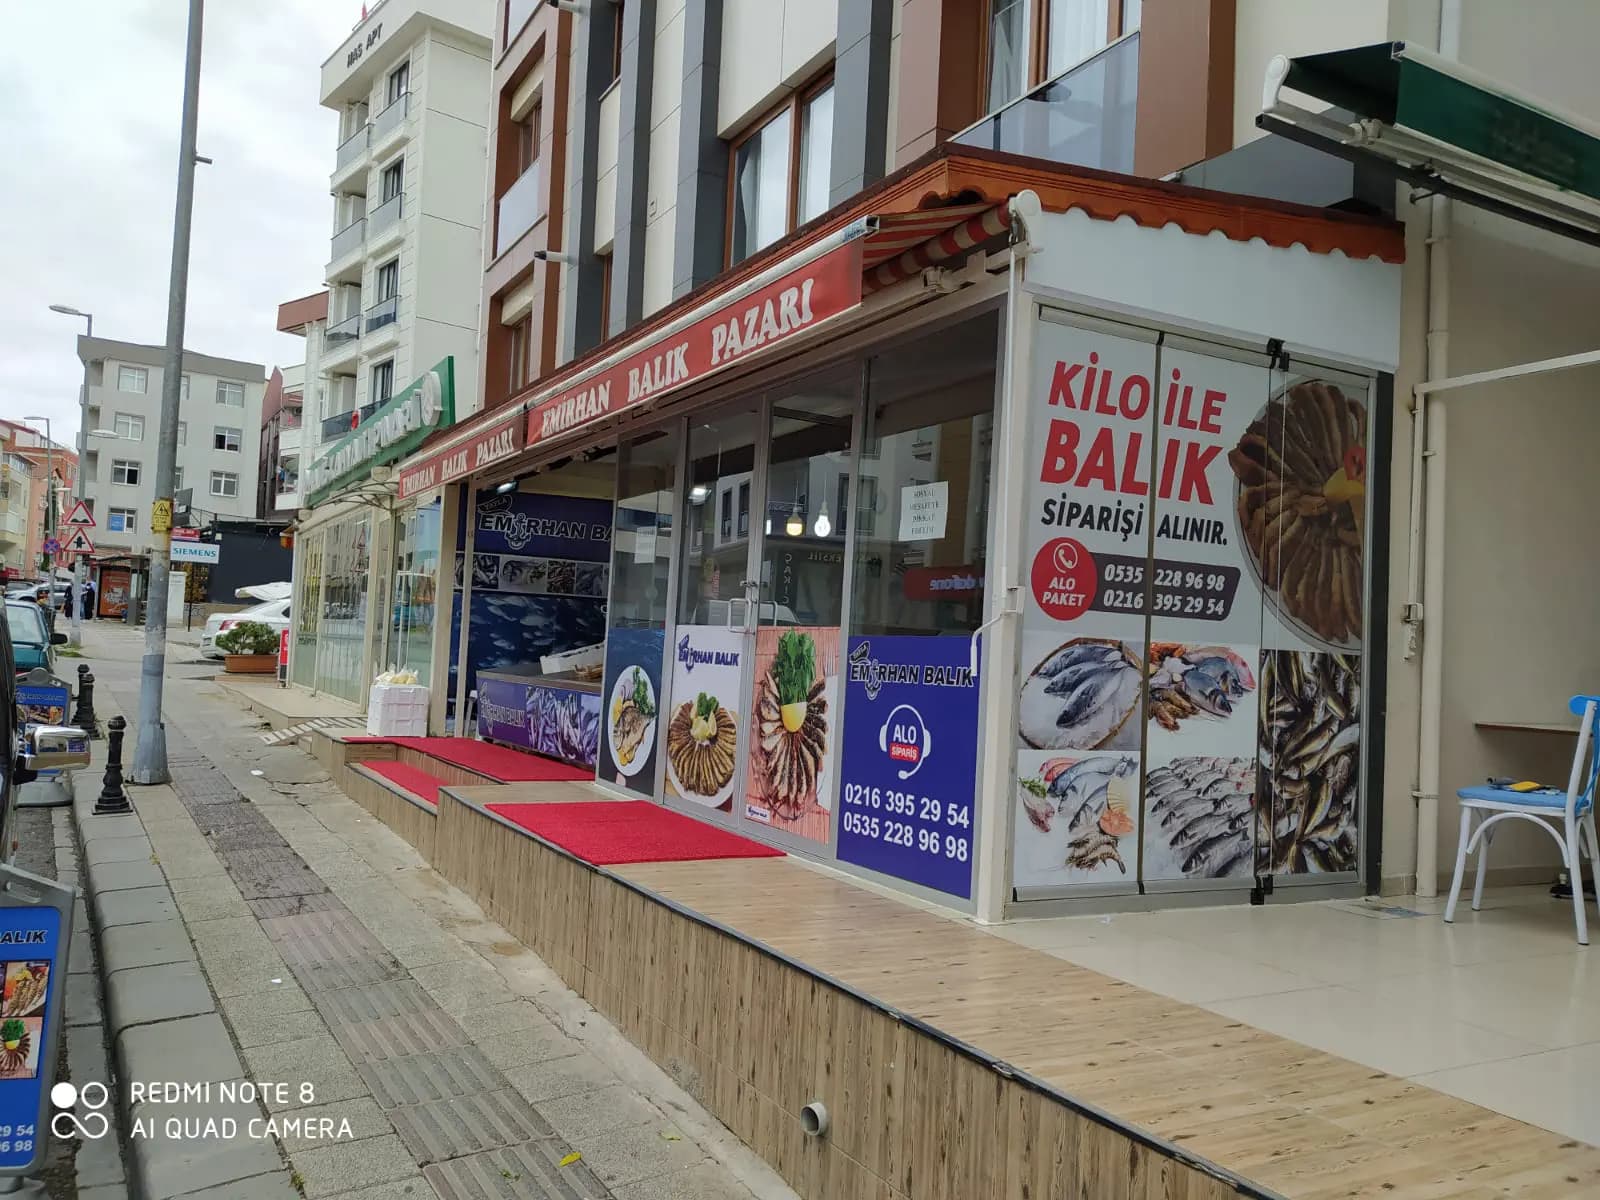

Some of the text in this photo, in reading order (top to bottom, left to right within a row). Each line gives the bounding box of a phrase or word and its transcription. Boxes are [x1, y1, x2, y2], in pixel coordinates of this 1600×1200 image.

[366, 23, 383, 50] APT
[541, 278, 814, 438] EMİRHAN BALIK PAZARI
[1048, 351, 1227, 434] KİLO İLE
[441, 449, 468, 480] BALIK
[475, 427, 514, 467] PAZARI
[1040, 418, 1223, 505] BALIK
[1040, 492, 1228, 546] SİPARİŞİ ALINIR.
[173, 547, 216, 558] SIEMENS
[1049, 577, 1076, 590] ALO
[1104, 564, 1225, 591] 0535 228 96 98
[1042, 592, 1086, 607] PAKET
[1103, 589, 1225, 615] 0216 395 29 54
[715, 652, 740, 667] BALIK
[923, 665, 974, 687] BALIK
[893, 724, 917, 744] ALO
[891, 745, 918, 760] SİPARİŞ
[845, 783, 969, 829] 0216 395 29 54
[843, 812, 968, 862] 0535 228 96 98
[0, 929, 48, 945] ALIK
[16, 1124, 34, 1137] 54
[0, 1140, 33, 1153] 6 98
